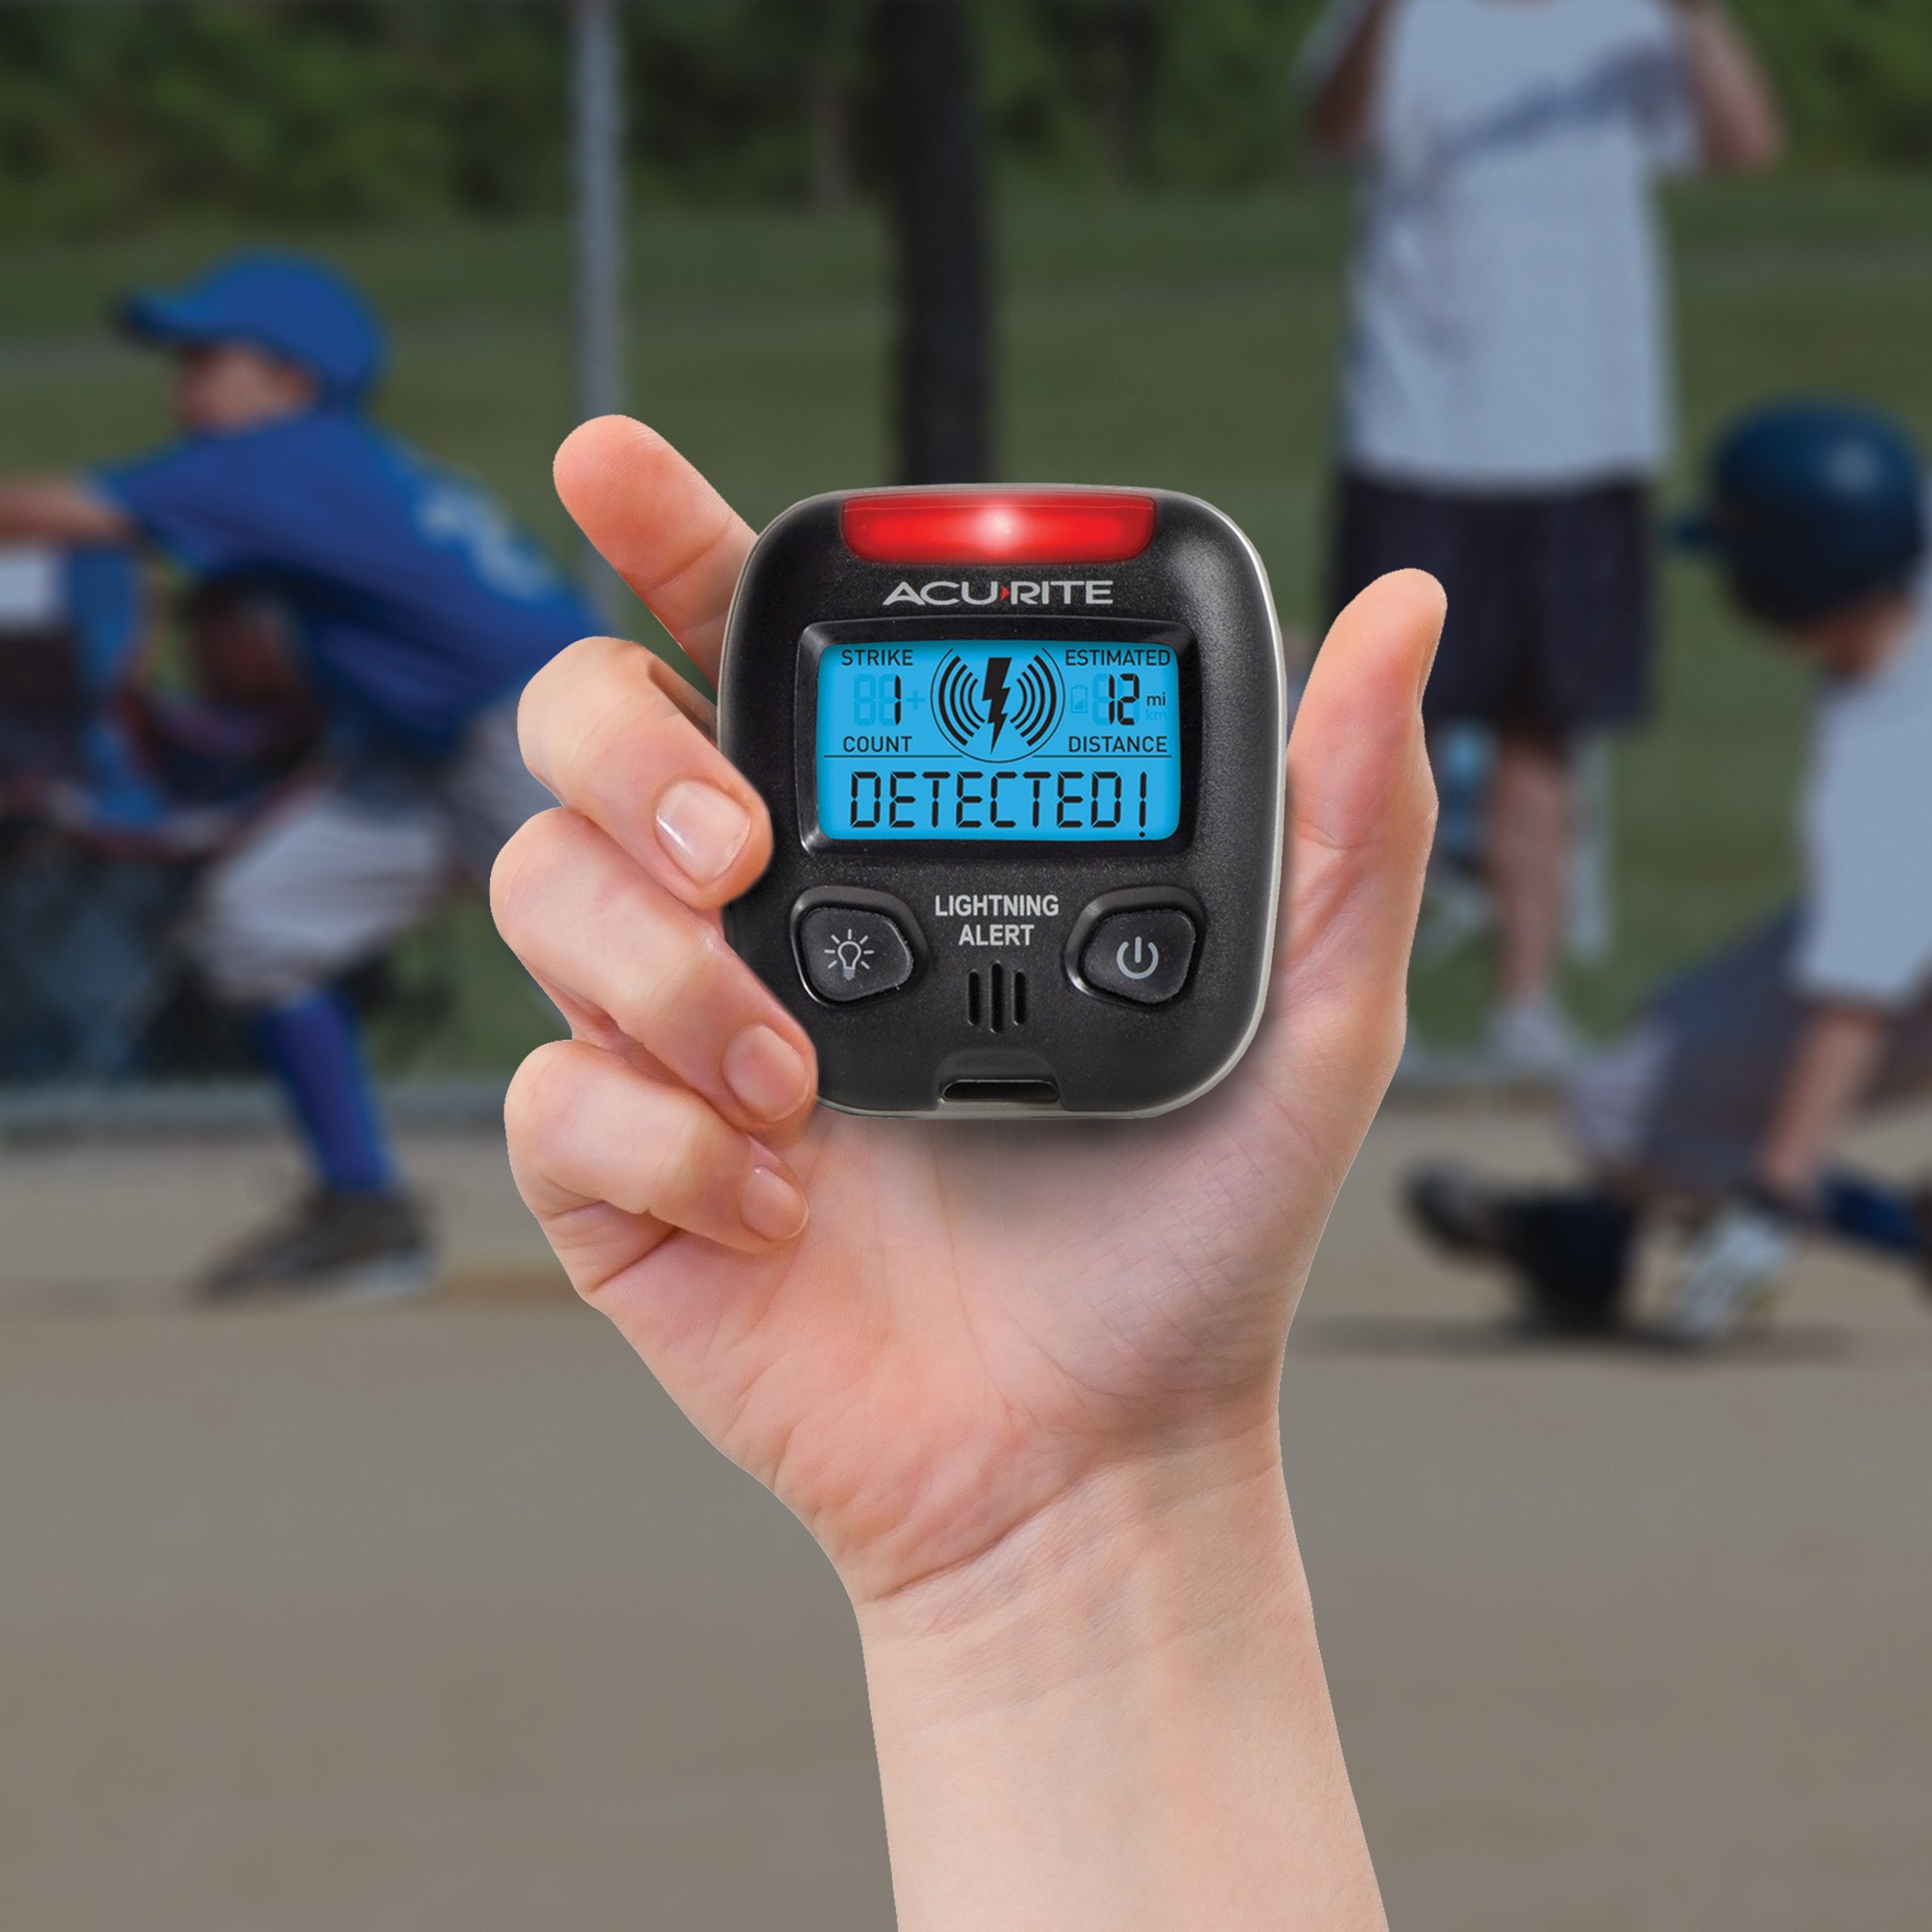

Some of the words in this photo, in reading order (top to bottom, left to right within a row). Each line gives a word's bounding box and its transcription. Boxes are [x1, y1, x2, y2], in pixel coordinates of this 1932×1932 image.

[882, 580, 1113, 605] ACURITE
[841, 649, 913, 666] STRIKE
[1065, 649, 1171, 666] ESTIMATED
[1108, 673, 1140, 726] 12
[1146, 693, 1166, 707] mi
[843, 736, 912, 752] COUNT
[1069, 736, 1167, 752] DISTANCE
[850, 771, 1148, 838] DETECTED!
[934, 894, 1060, 918] LIGHTNING
[958, 924, 1035, 946] ALERT
